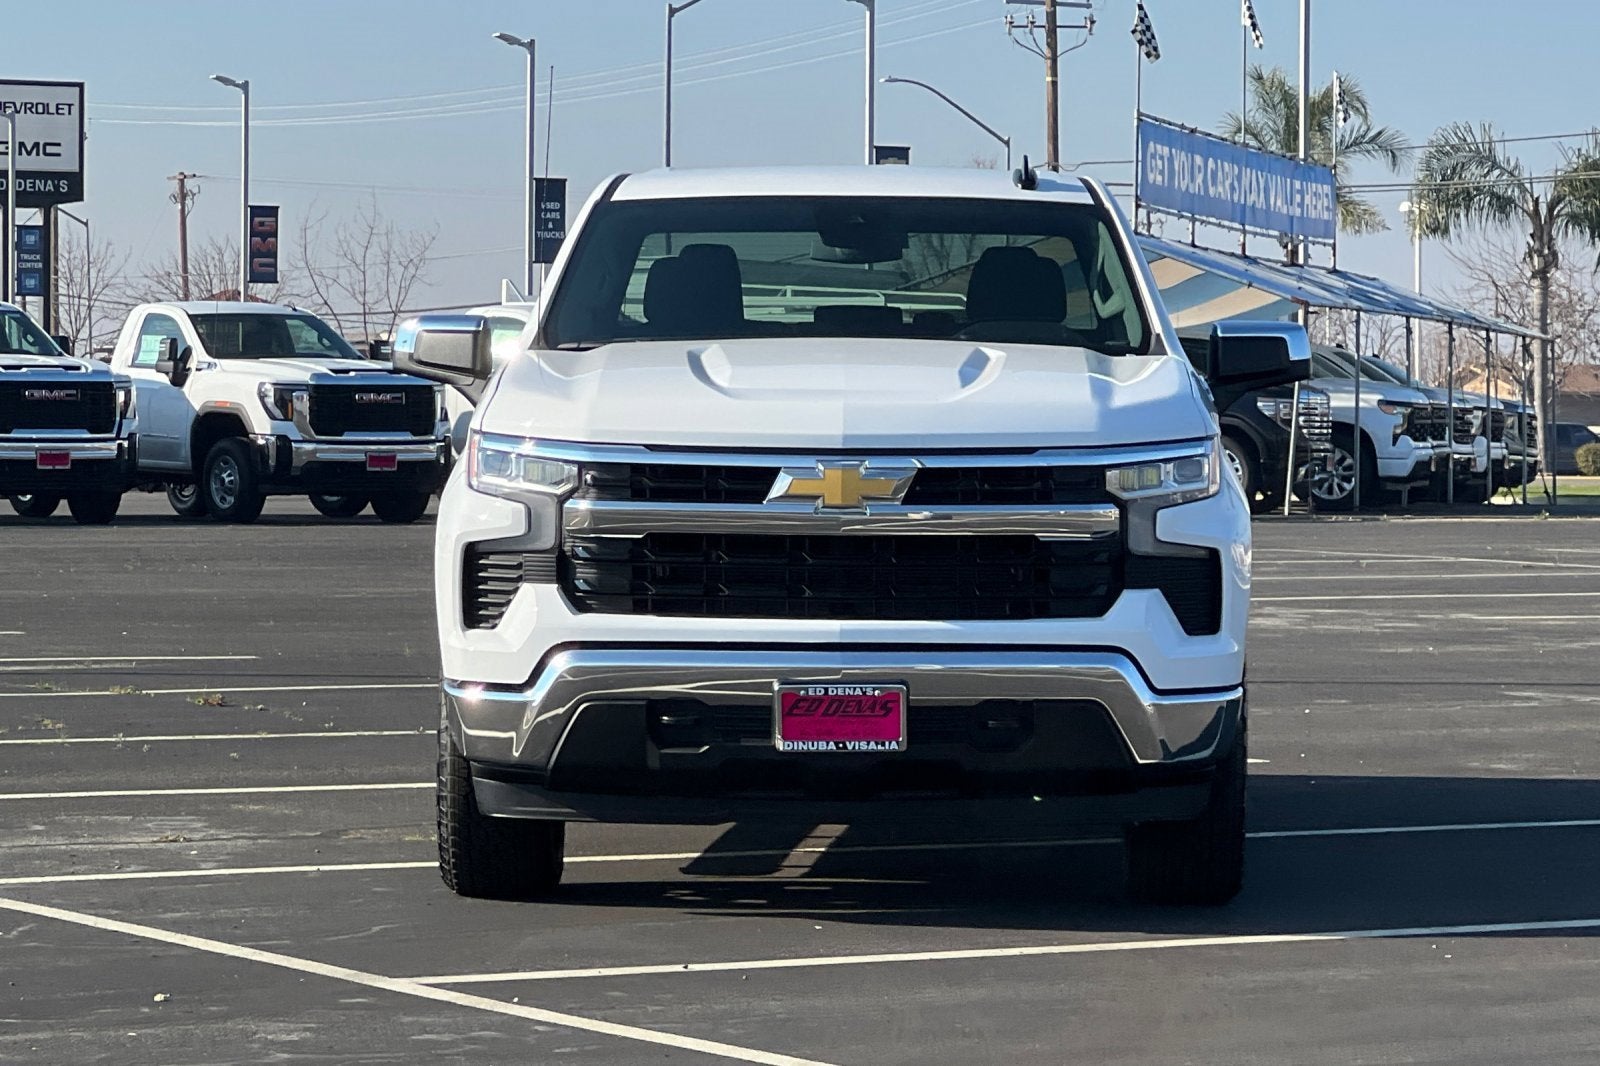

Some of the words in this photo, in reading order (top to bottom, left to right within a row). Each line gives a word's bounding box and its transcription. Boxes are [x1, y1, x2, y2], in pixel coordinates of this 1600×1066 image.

[0, 102, 74, 115] EVROLET
[16, 179, 68, 192] DENA'S
[1147, 141, 1170, 187] GET
[1172, 148, 1204, 196] YOUR
[1240, 166, 1266, 210] MAX
[1303, 181, 1333, 220] HERE!
[541, 202, 560, 210] USED
[251, 217, 277, 272] GMC
[25, 389, 77, 400] GMC
[355, 393, 402, 404] GMC
[808, 687, 824, 696] ED
[828, 687, 874, 696] DENA'S
[785, 699, 824, 717] ED
[784, 741, 837, 750] DINUBA
[846, 741, 899, 750] VISALIA
